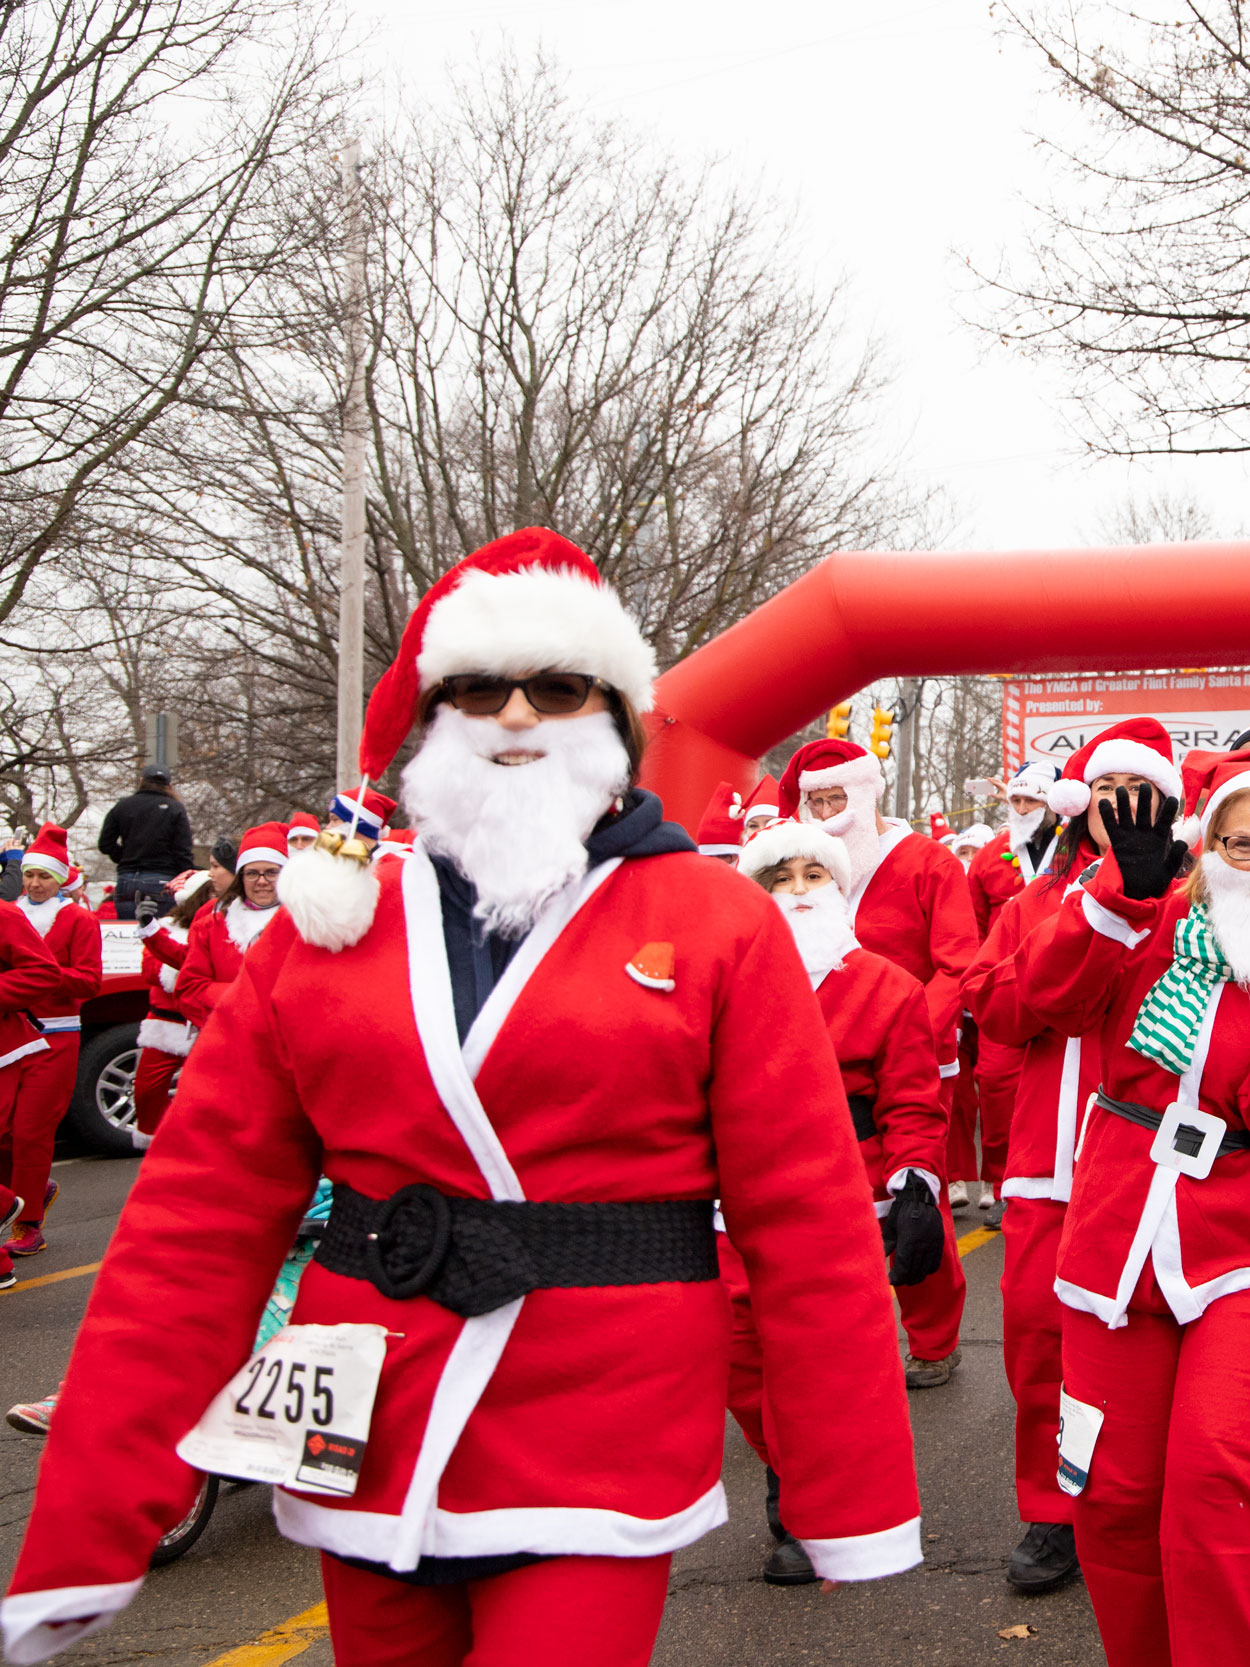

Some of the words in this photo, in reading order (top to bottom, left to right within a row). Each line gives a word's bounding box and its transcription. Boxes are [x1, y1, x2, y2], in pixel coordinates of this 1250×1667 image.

[1024, 682, 1043, 695] The
[1046, 680, 1079, 694] YMCA
[1081, 680, 1092, 692] of
[1095, 678, 1140, 692] Greater
[1143, 676, 1167, 689] Flint
[1170, 675, 1206, 690] Family
[1208, 674, 1241, 688] Santa
[1026, 699, 1084, 714] Presented
[1086, 698, 1104, 713] by:
[234, 1356, 334, 1426] 2255
